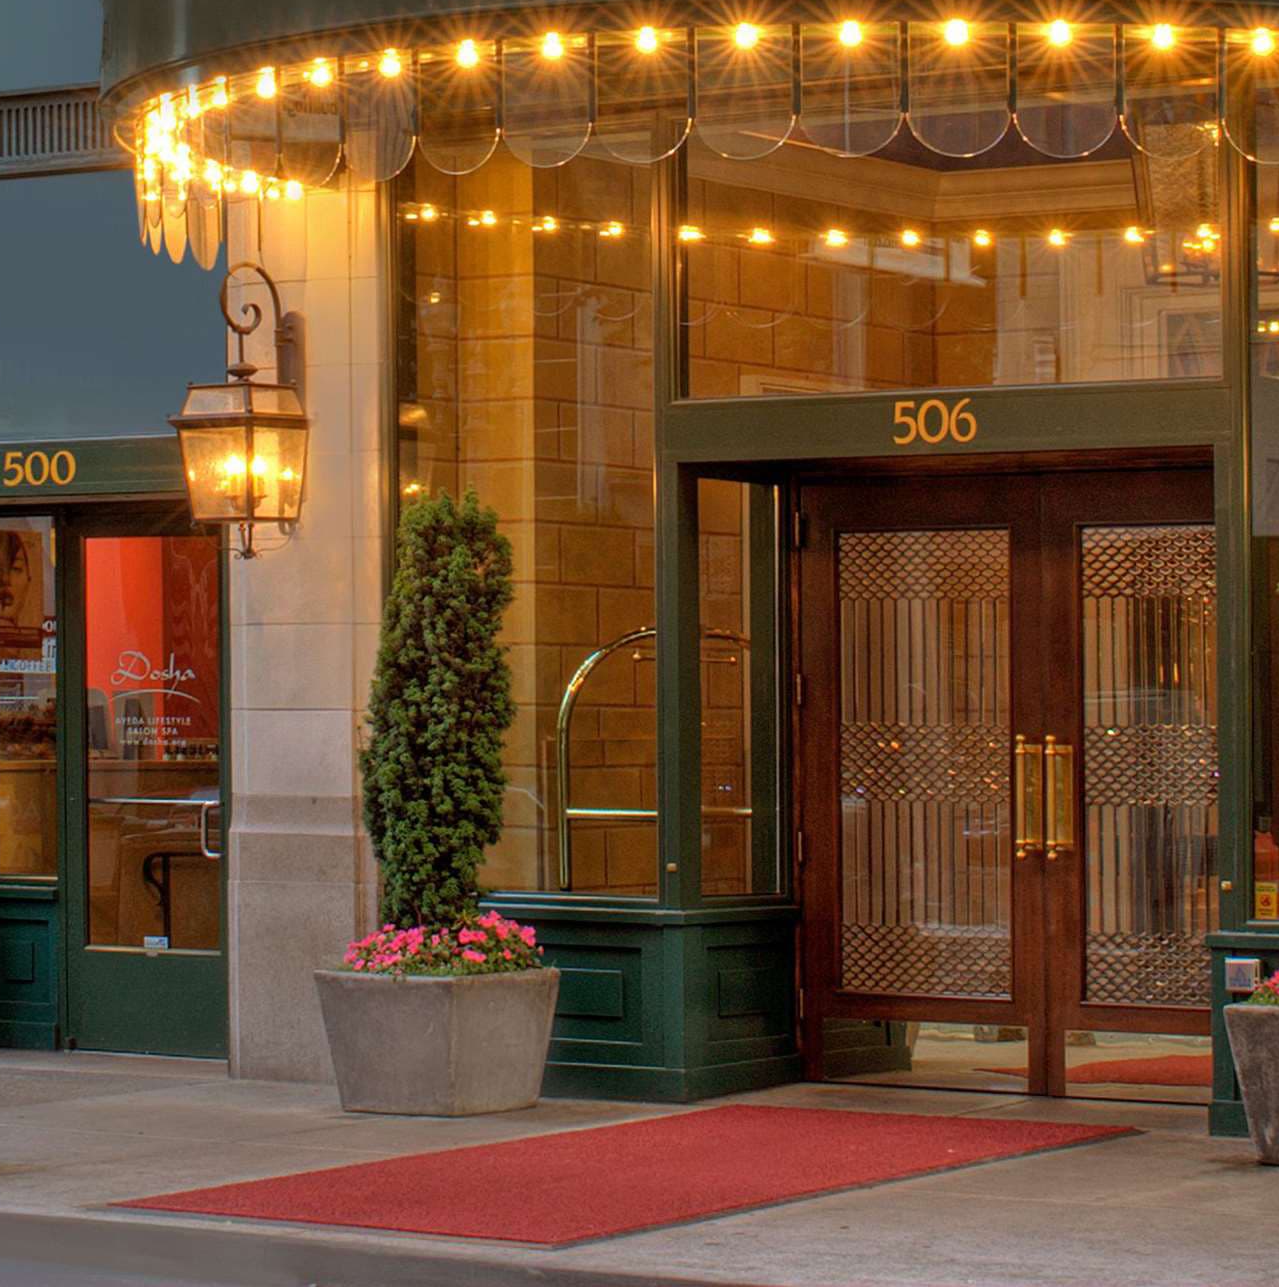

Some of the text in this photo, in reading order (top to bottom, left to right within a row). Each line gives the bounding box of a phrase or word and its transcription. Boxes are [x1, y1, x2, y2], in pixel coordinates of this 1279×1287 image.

[893, 398, 977, 445] 506
[3, 450, 76, 488] 500
[111, 650, 196, 700] Dosha
[115, 716, 191, 726] AVEDA LIFESTYLE
[127, 727, 178, 736] SALON SPA
